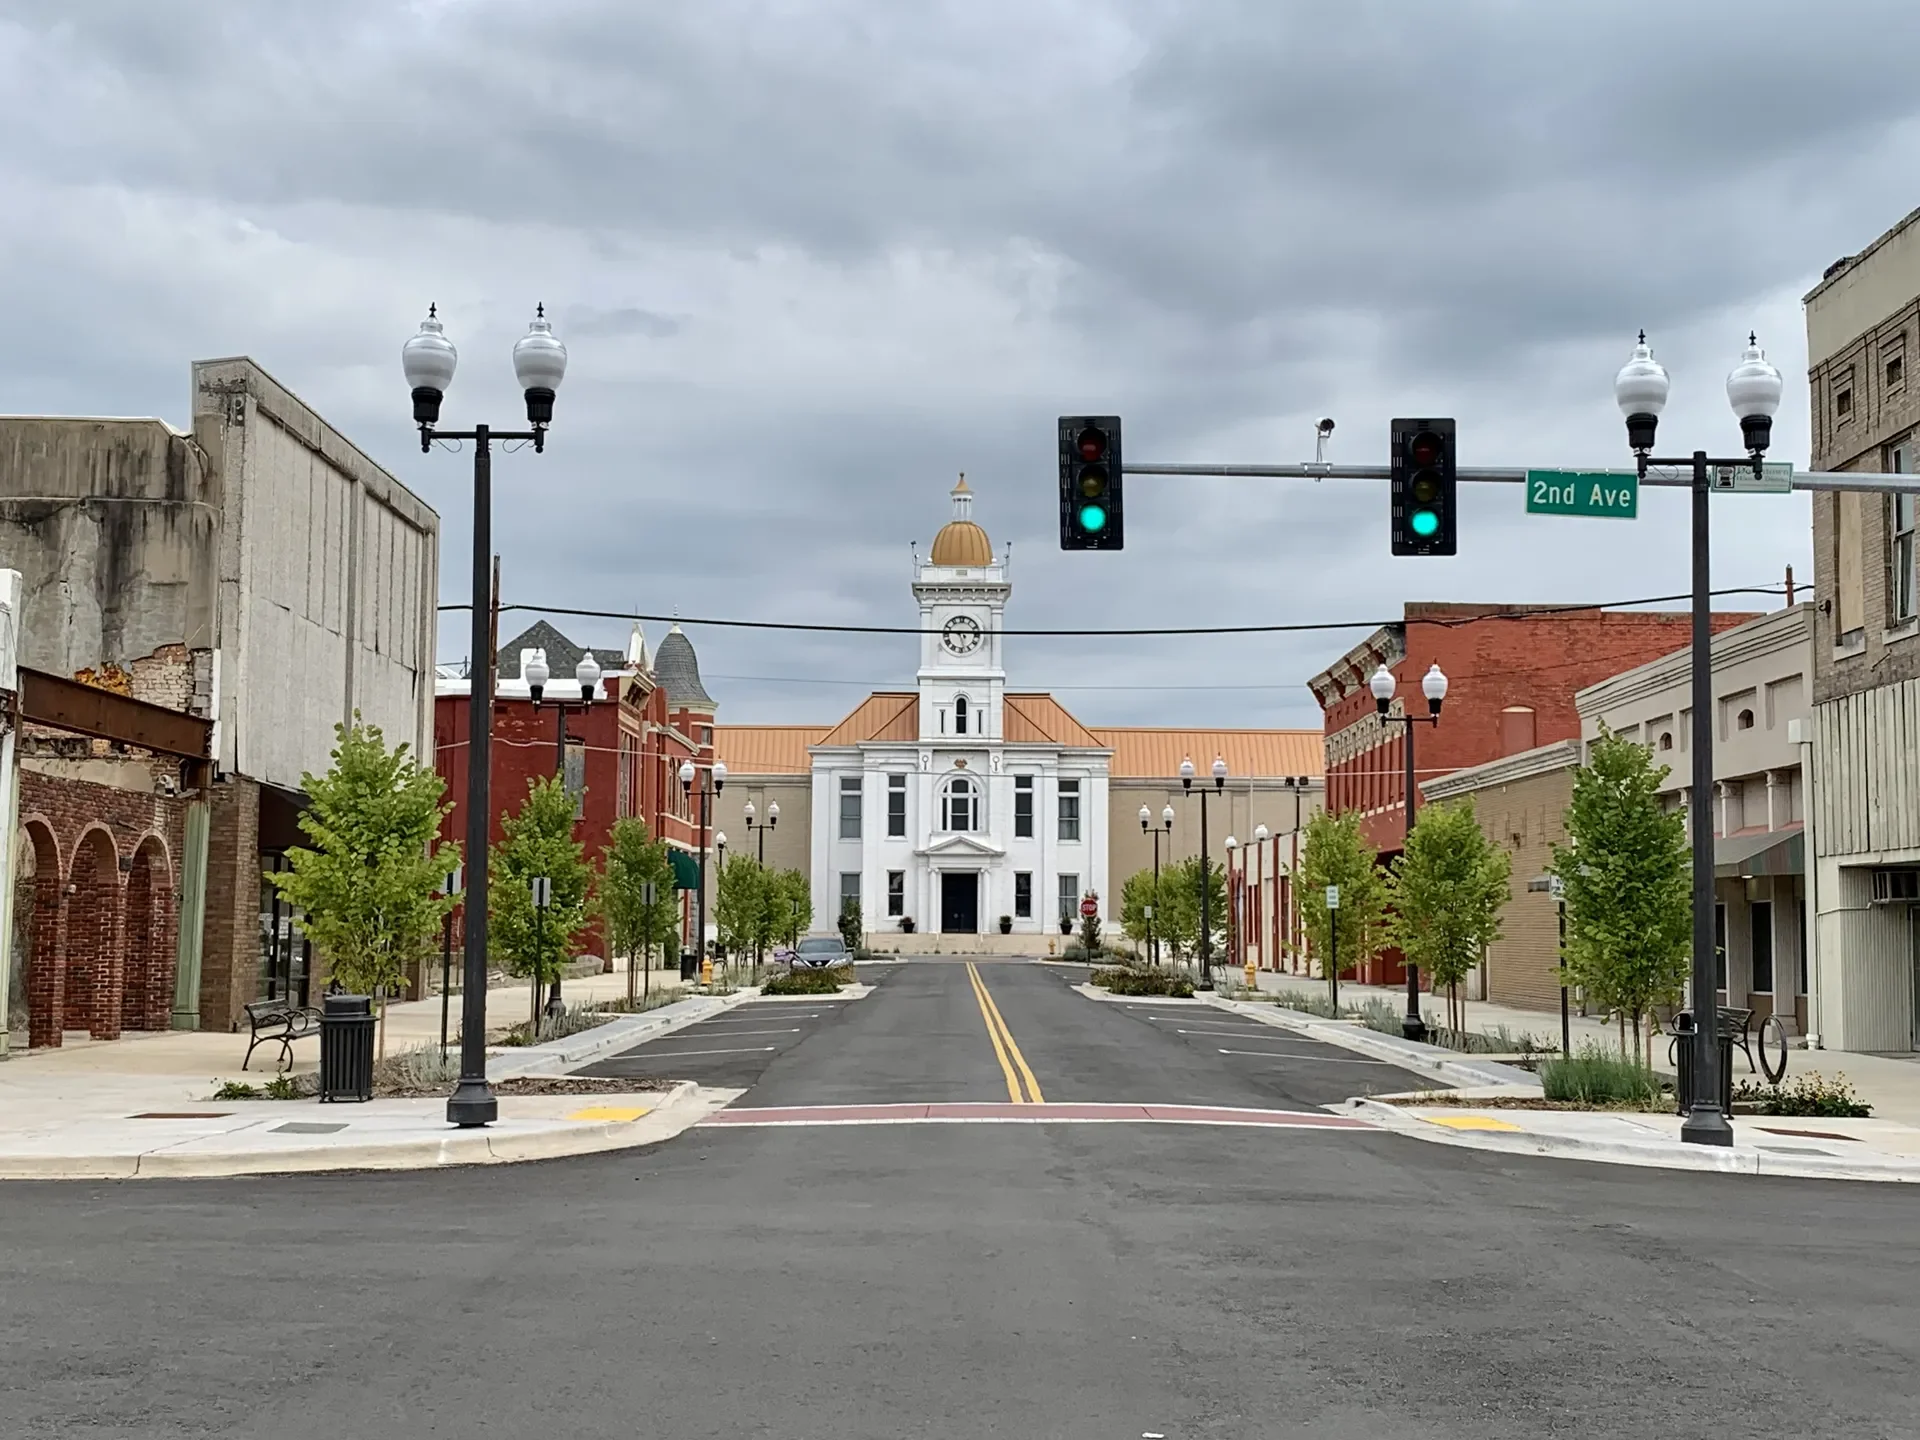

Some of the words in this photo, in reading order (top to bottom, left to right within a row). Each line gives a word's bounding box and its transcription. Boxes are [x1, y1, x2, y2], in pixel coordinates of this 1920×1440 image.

[1533, 480, 1575, 505] 2nd
[1589, 483, 1631, 507] Ave
[1083, 903, 1097, 911] STOP
